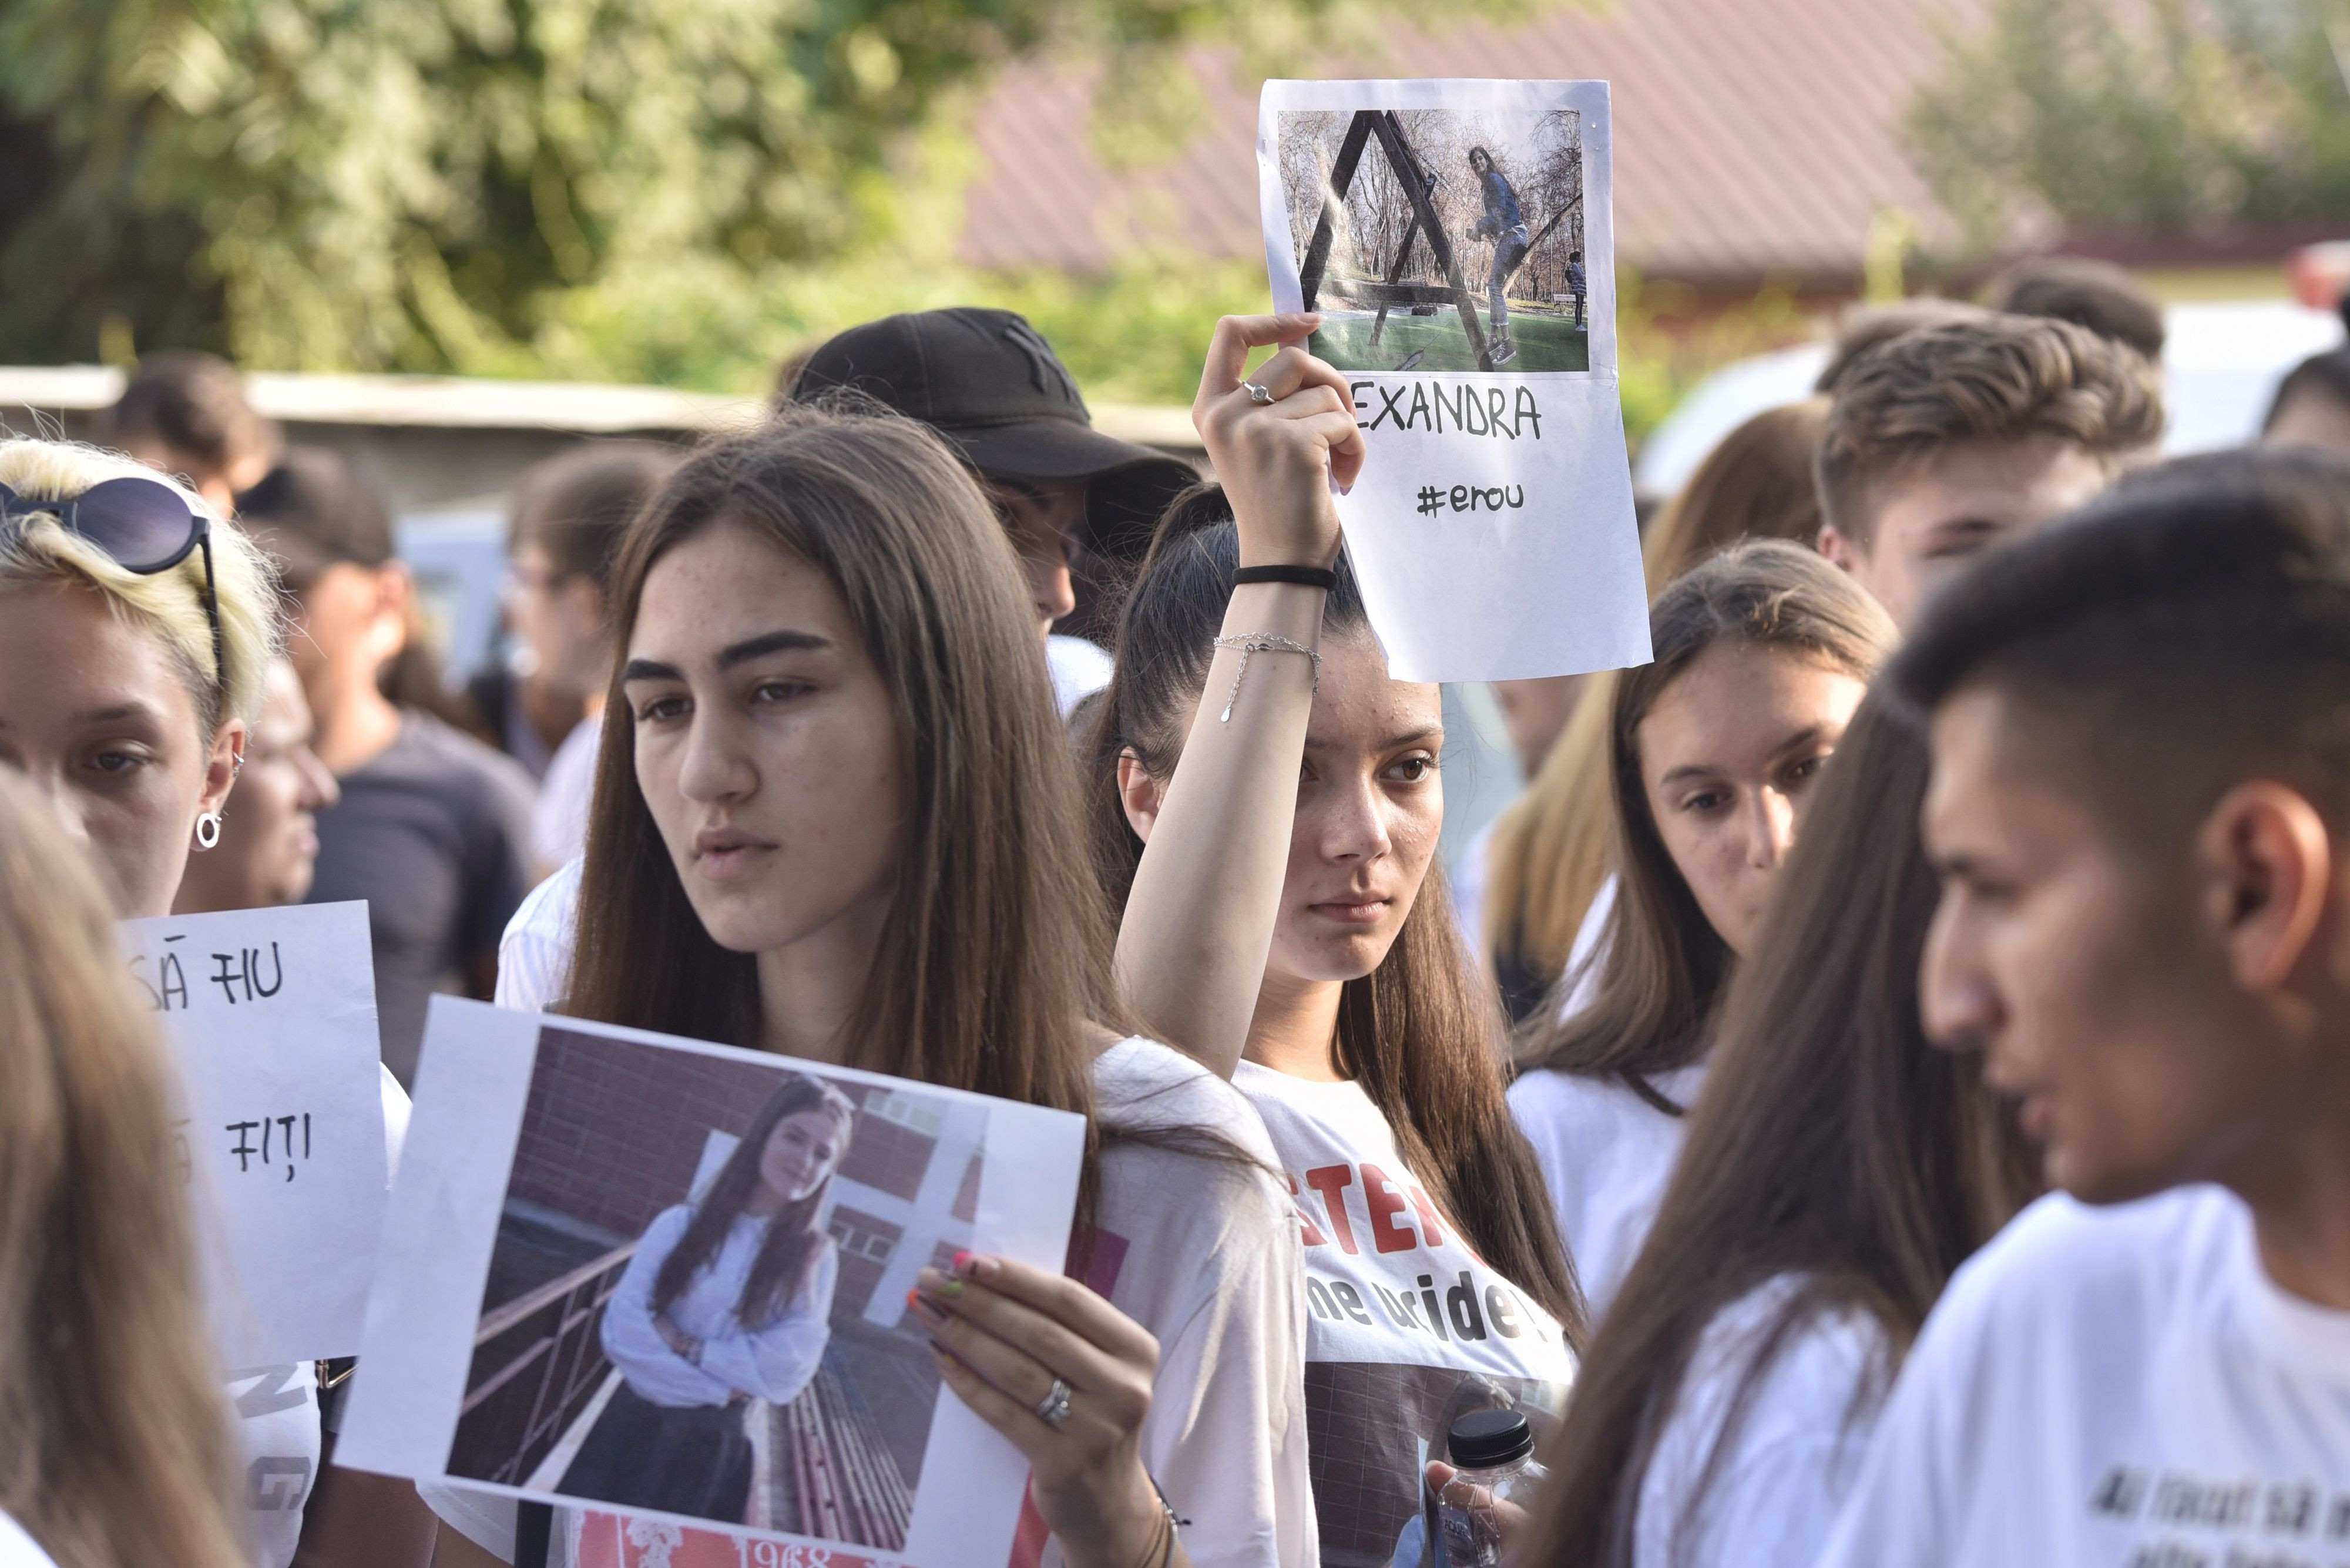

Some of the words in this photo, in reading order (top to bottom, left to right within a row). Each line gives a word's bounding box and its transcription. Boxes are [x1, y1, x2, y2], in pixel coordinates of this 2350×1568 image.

[1416, 483, 1525, 519] #erou
[210, 941, 283, 1005] FIU
[1307, 1276, 1373, 1326] ne
